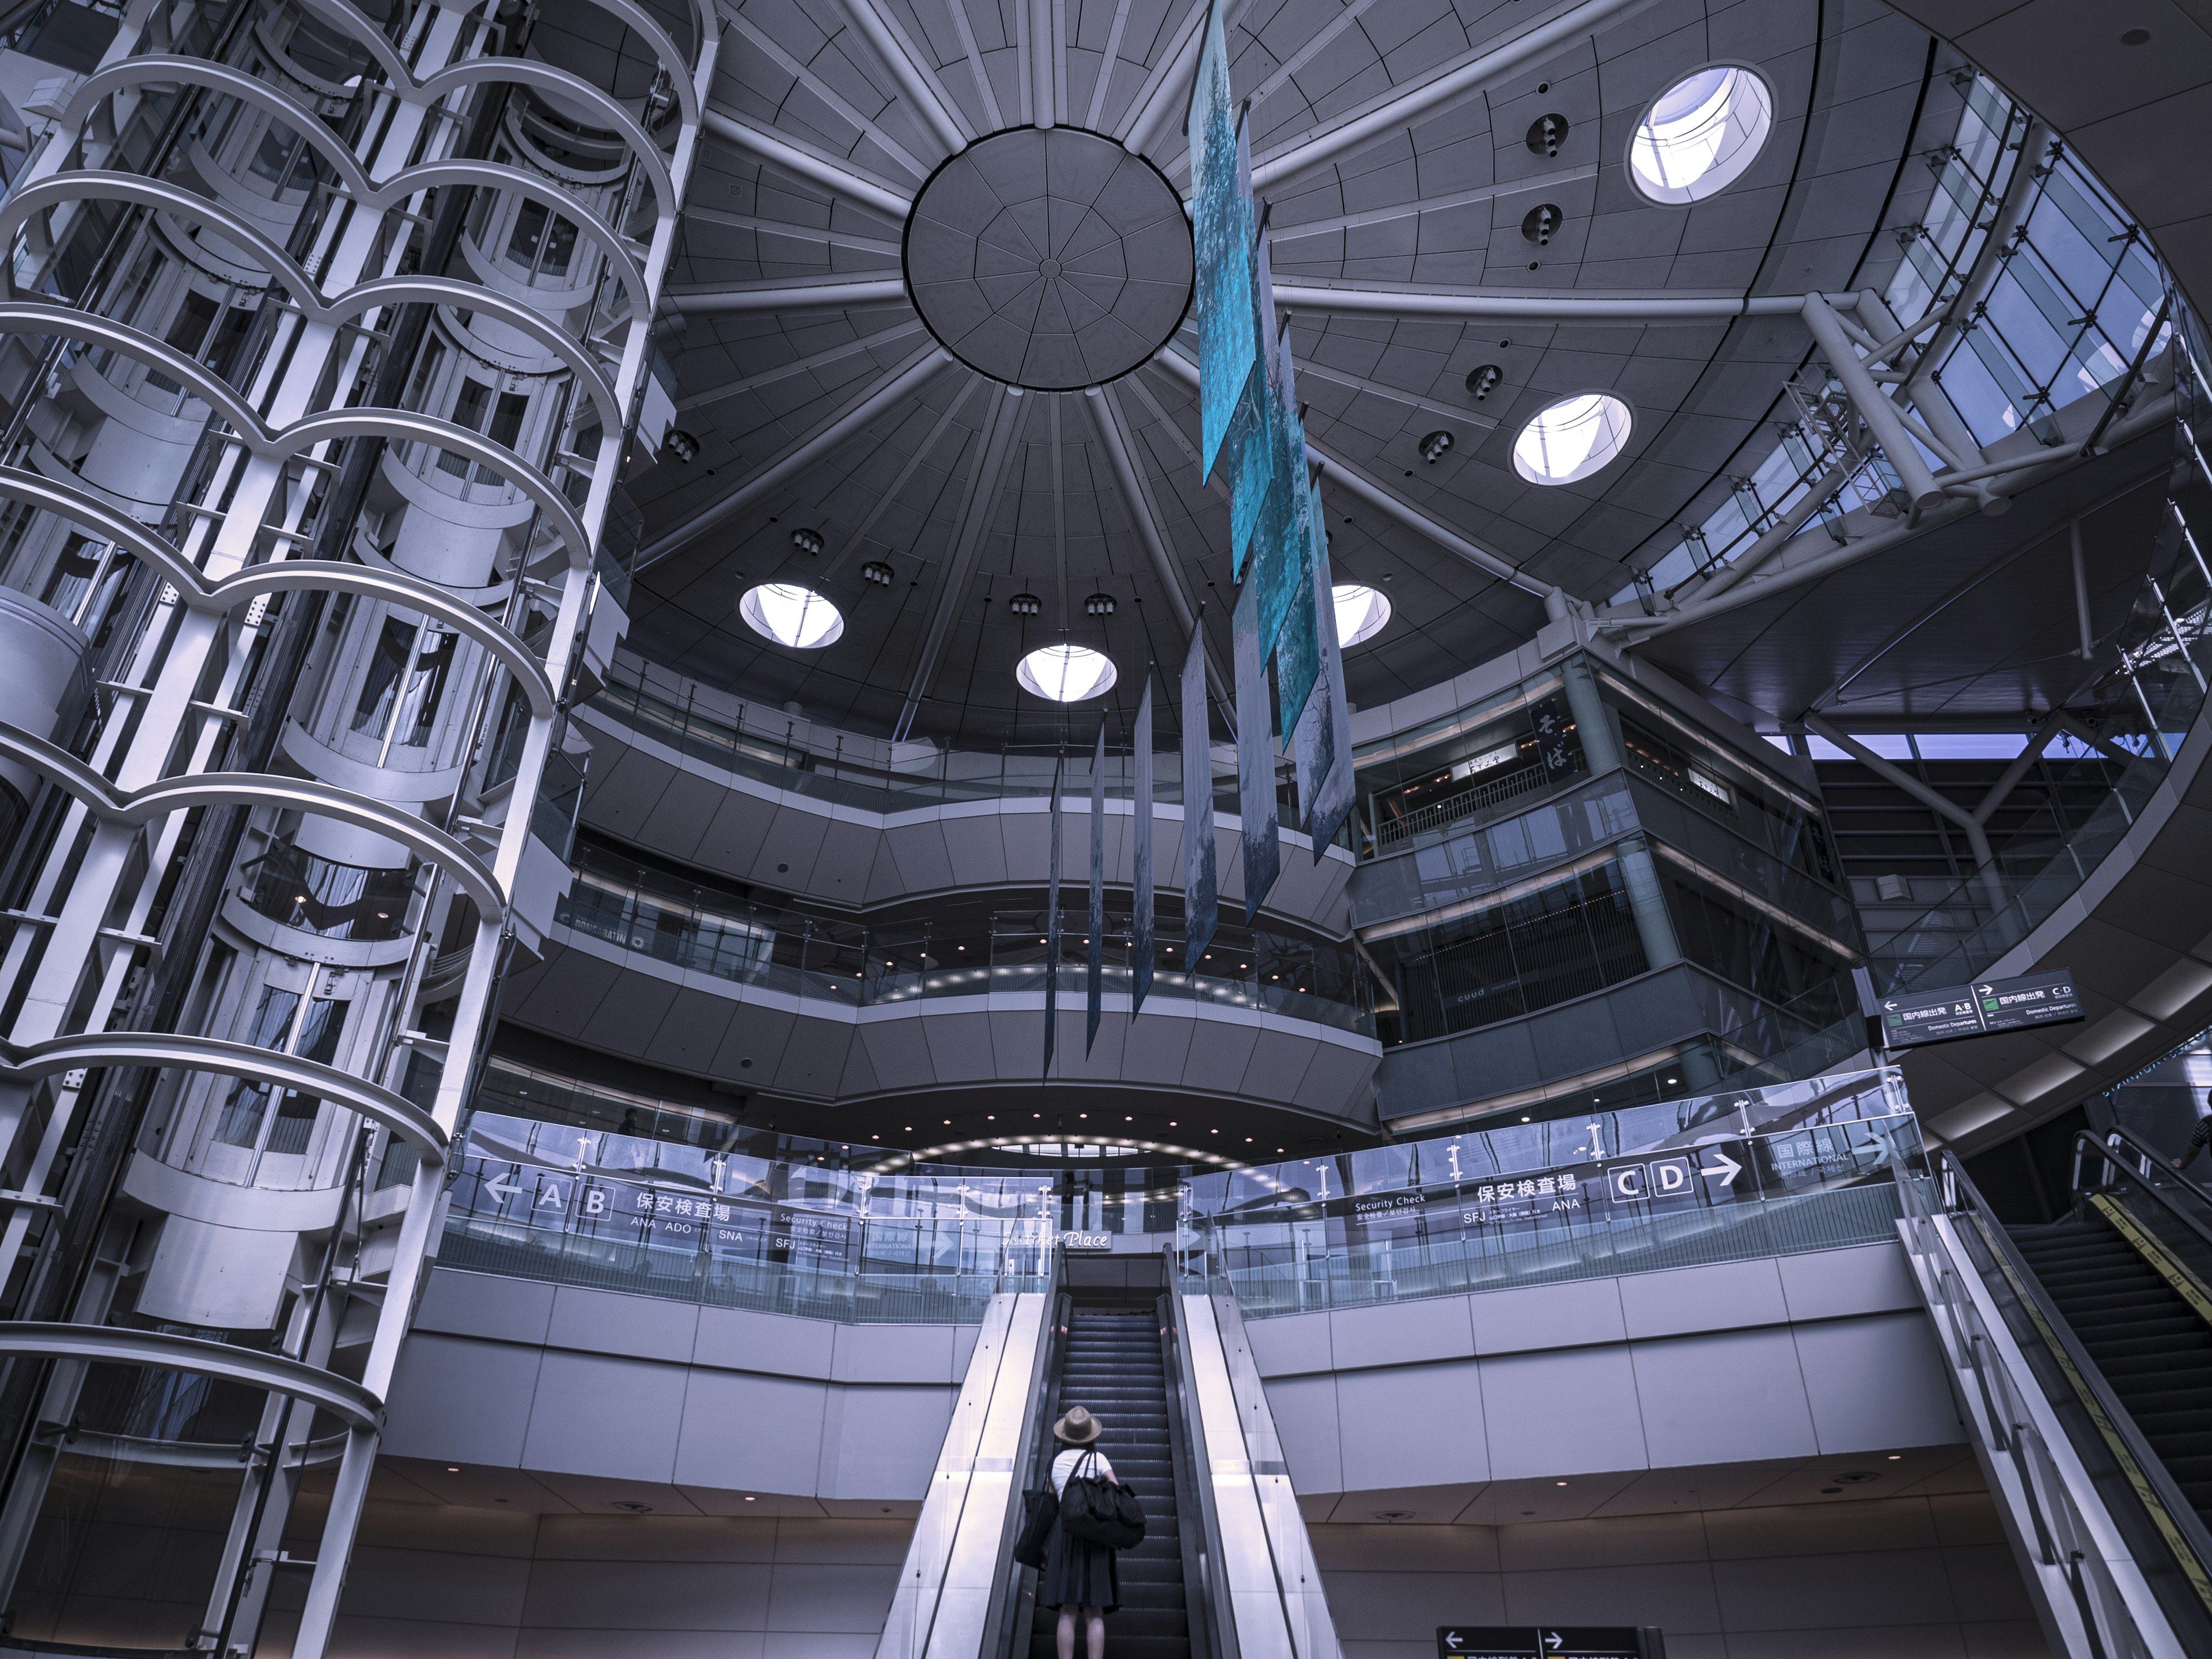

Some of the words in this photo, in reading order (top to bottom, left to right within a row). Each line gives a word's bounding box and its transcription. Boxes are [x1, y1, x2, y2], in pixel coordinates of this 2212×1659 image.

[1539, 714, 1567, 770] そば
[1457, 988, 1484, 1002] cuud
[1999, 990, 2046, 1005] 国内線出発
[1902, 1007, 1947, 1021] 国内線出発
[2025, 1007, 2049, 1015] Domestic
[2049, 1003, 2077, 1012] Departures
[1950, 1019, 1978, 1027] Departures
[1777, 1138, 1834, 1159] 国際線
[1771, 1153, 1849, 1171] INTERNATIONAL
[1478, 1173, 1576, 1203] 保安検査場
[1618, 1170, 1639, 1195] C
[1659, 1165, 1684, 1190] D
[538, 1184, 562, 1208] A
[586, 1190, 605, 1214] B
[637, 1192, 730, 1222] 保安検査場
[1355, 1199, 1393, 1211] Security
[1396, 1194, 1426, 1205] Check
[1552, 1198, 1581, 1211] ANA
[781, 1213, 817, 1228] Security
[820, 1219, 847, 1231] Check
[1464, 1211, 1486, 1224] SFJ
[631, 1217, 656, 1228] ANA
[665, 1222, 692, 1233] ADO
[719, 1229, 743, 1242] SNA
[775, 1238, 796, 1249] SFJ
[872, 1232, 908, 1242] 国際線
[1063, 1230, 1107, 1247] Place
